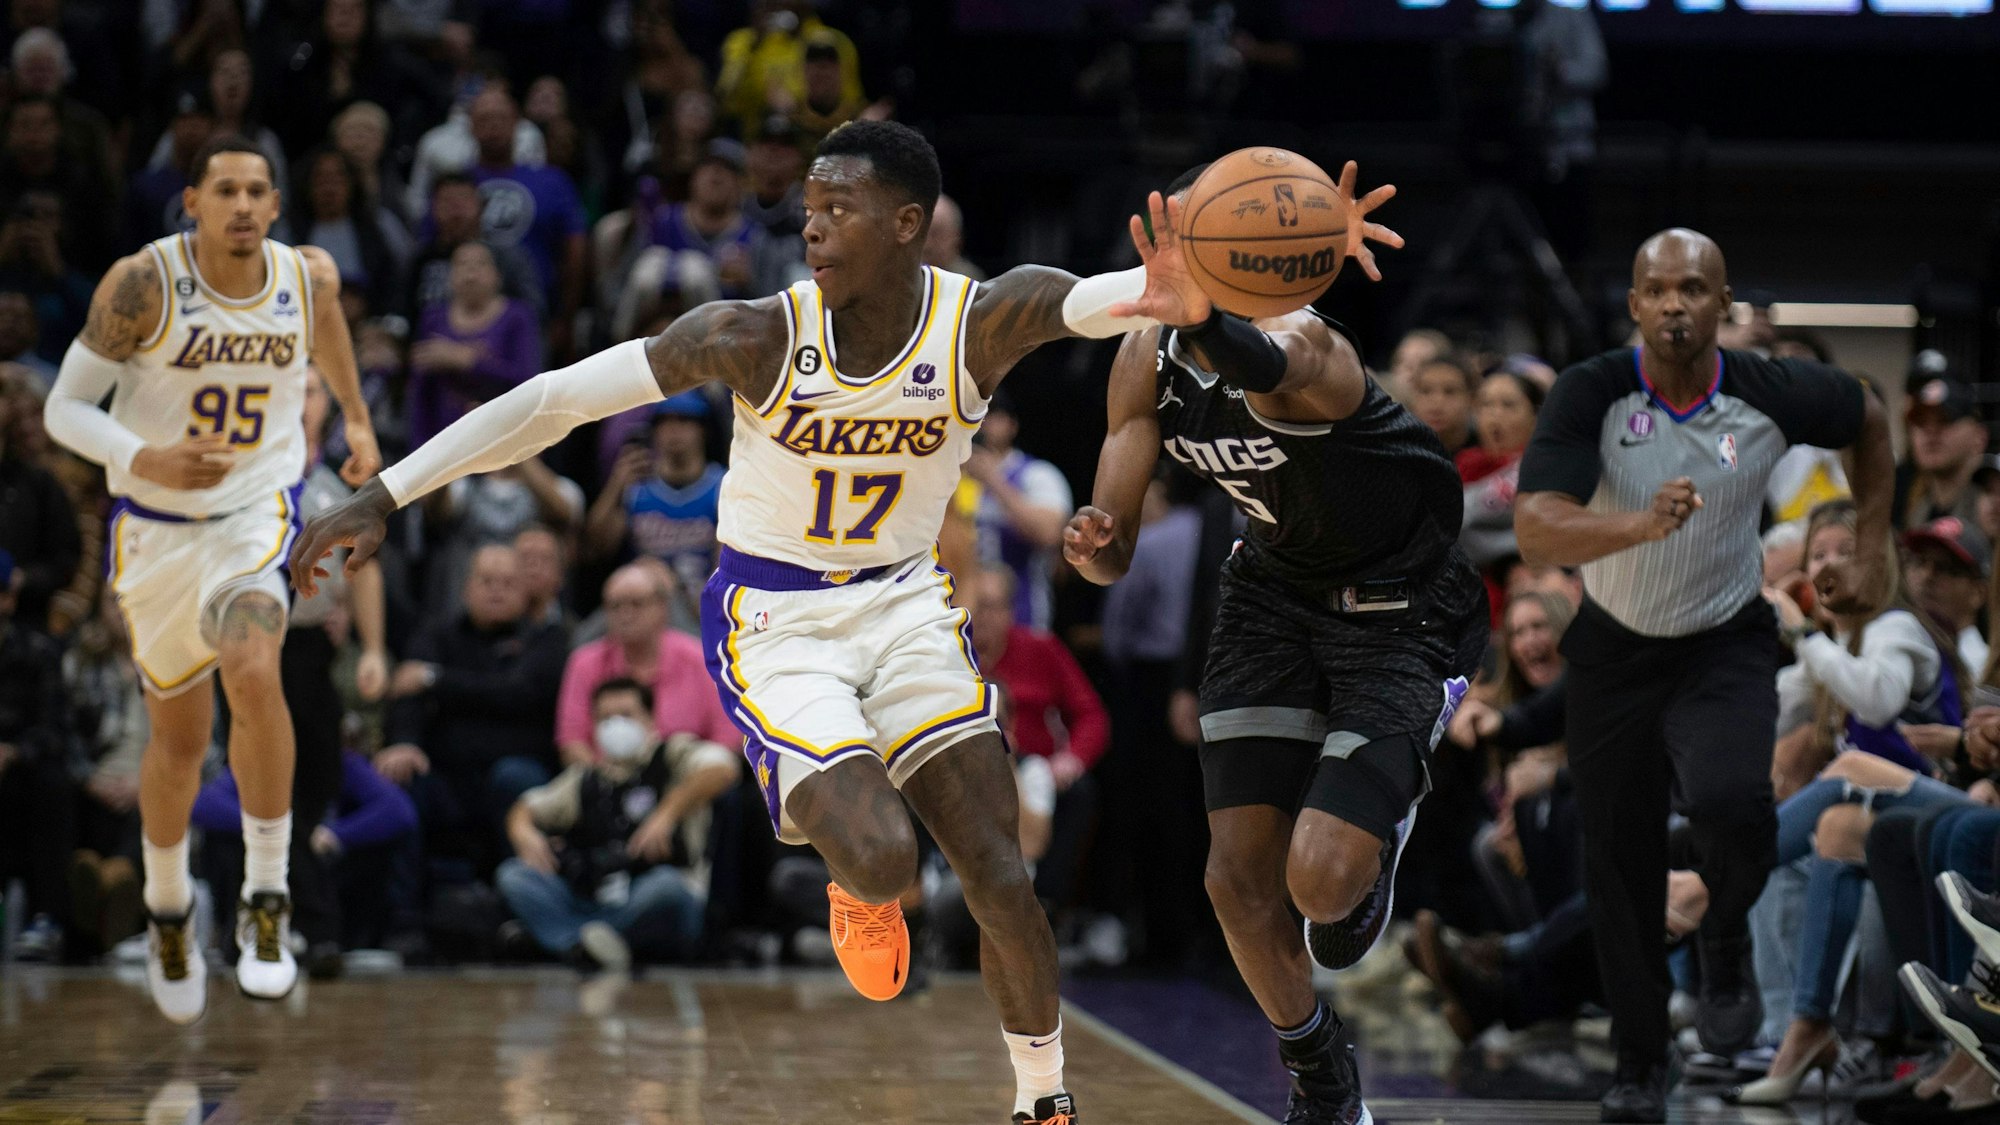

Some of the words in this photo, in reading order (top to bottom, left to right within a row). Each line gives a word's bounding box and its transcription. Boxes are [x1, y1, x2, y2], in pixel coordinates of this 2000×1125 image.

[1229, 246, 1335, 283] Wilson
[166, 325, 297, 369] LAKERS
[800, 349, 817, 373] 6
[187, 383, 272, 449] 95
[902, 386, 946, 401] bibigo
[770, 404, 951, 457] LAKERS
[804, 466, 906, 545] 17
[1214, 476, 1278, 524] 5
